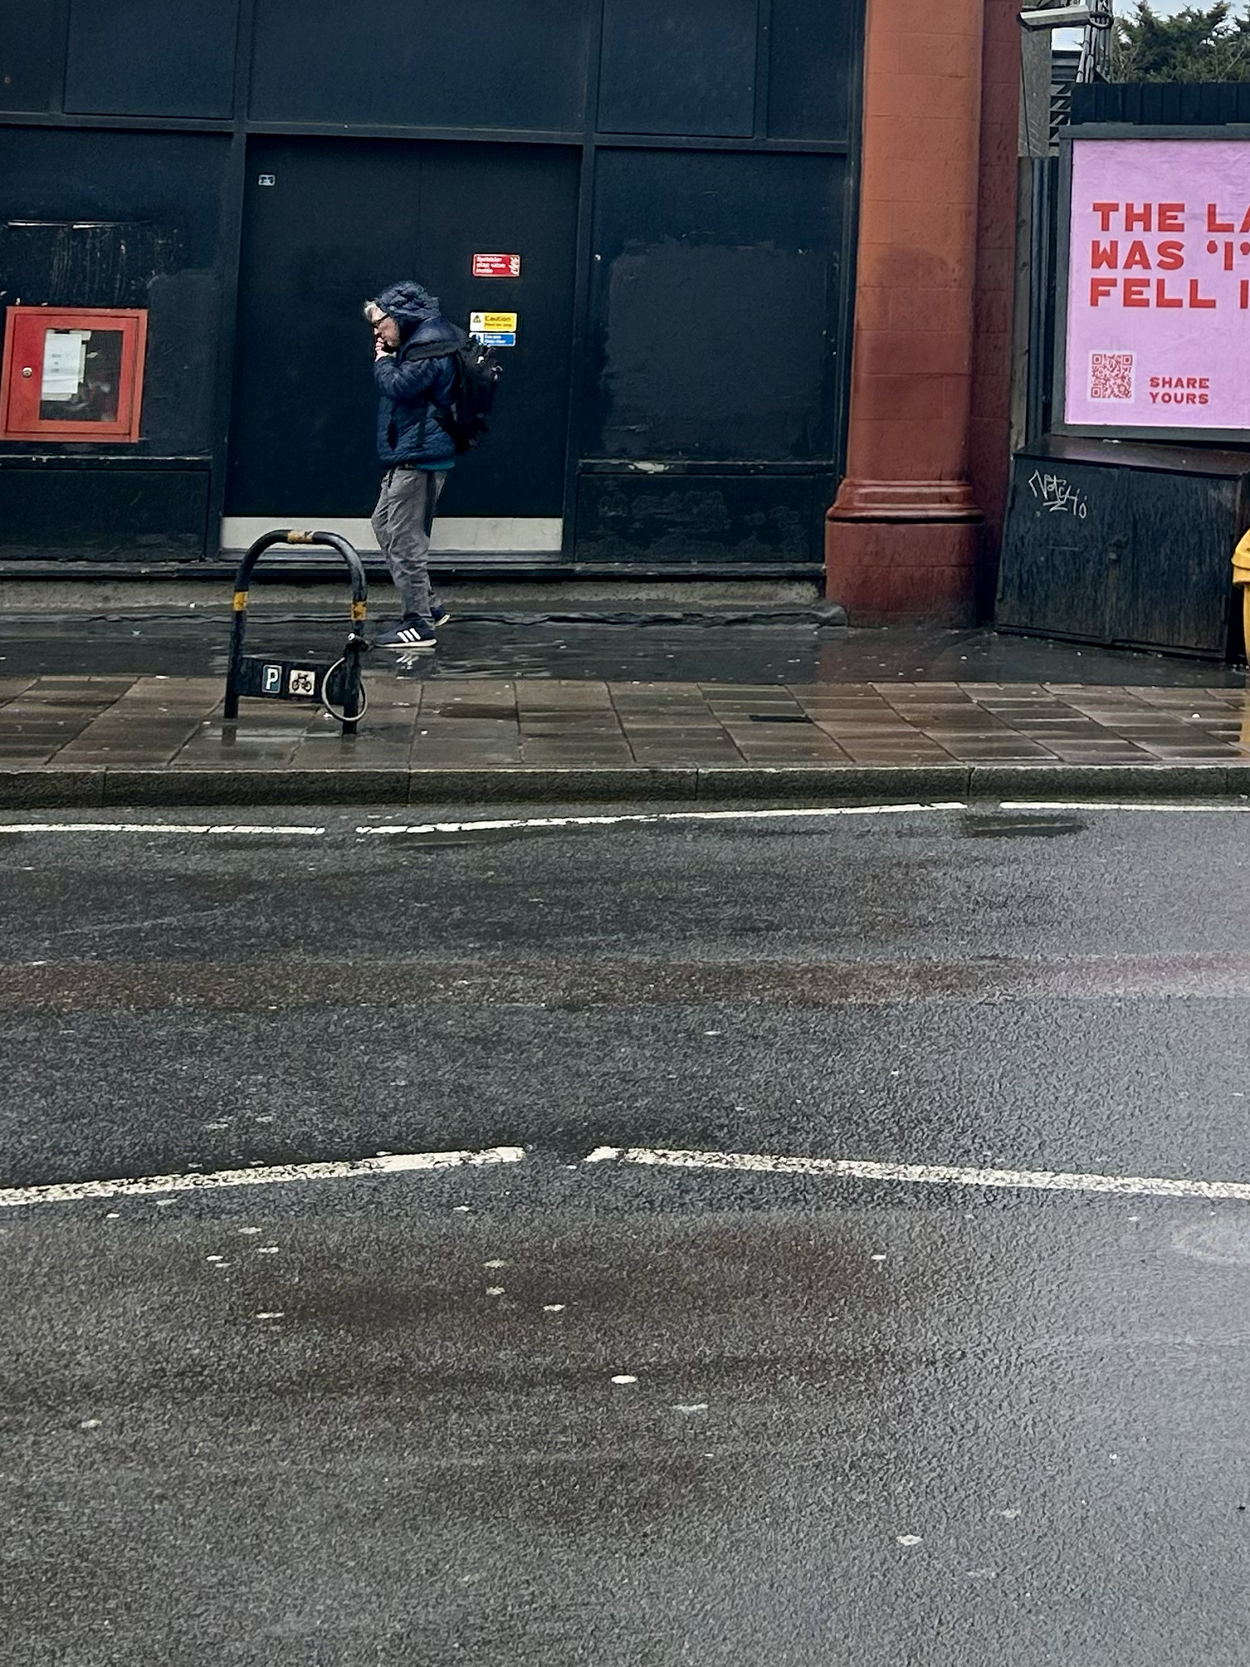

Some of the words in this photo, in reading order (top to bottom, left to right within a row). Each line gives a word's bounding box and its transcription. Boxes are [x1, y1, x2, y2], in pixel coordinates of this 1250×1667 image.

[1092, 201, 1185, 233] THE
[1090, 239, 1185, 271] WAS
[1089, 276, 1217, 309] FELL
[1149, 376, 1207, 389] SHARE
[1151, 391, 1208, 404] YOURS
[265, 668, 279, 690] P
